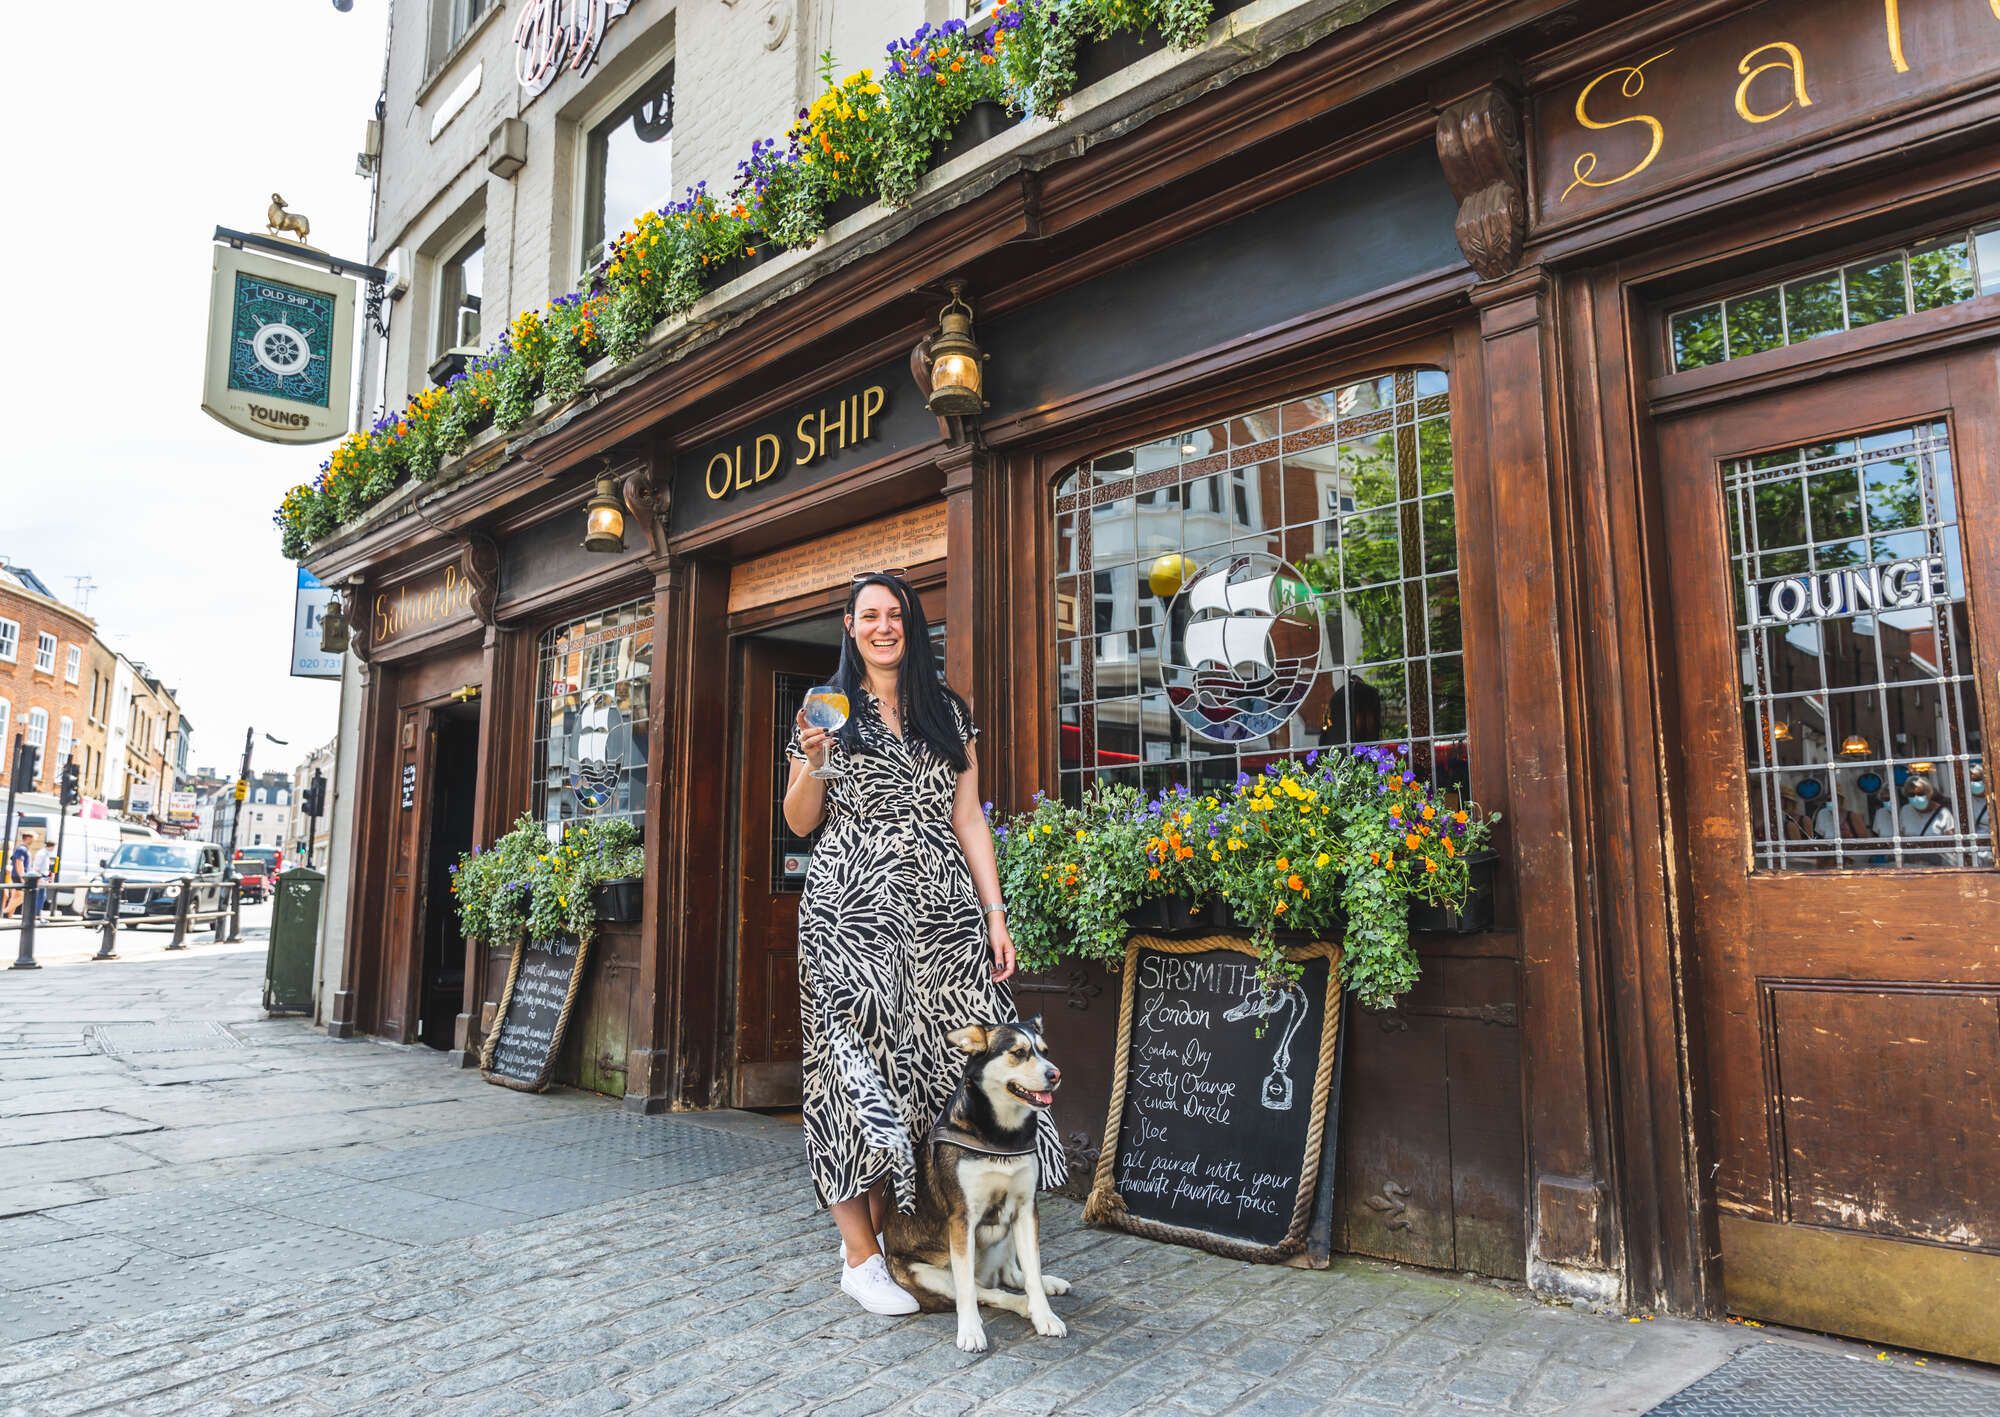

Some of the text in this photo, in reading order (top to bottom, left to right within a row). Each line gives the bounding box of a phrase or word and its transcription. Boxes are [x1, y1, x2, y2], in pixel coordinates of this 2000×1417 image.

[262, 288, 309, 306] OLD SHIP
[248, 403, 310, 427] YOUNG'S
[705, 385, 885, 500] OLD SHIP
[441, 565, 476, 616] Ba
[1750, 557, 1948, 626] LOUNGE
[299, 658, 320, 669] 020
[1139, 955, 1257, 997] SIPSMITH
[1139, 991, 1210, 1033] London
[1140, 1035, 1212, 1078] London Dry
[1136, 1064, 1236, 1106] Zesty Orange
[1183, 1094, 1231, 1125] Drizzle
[1132, 1116, 1168, 1147] Sloe
[1122, 1150, 1293, 1197] all paired with your
[1173, 1175, 1232, 1209] fevertree
[1235, 1186, 1279, 1219] tonic.
